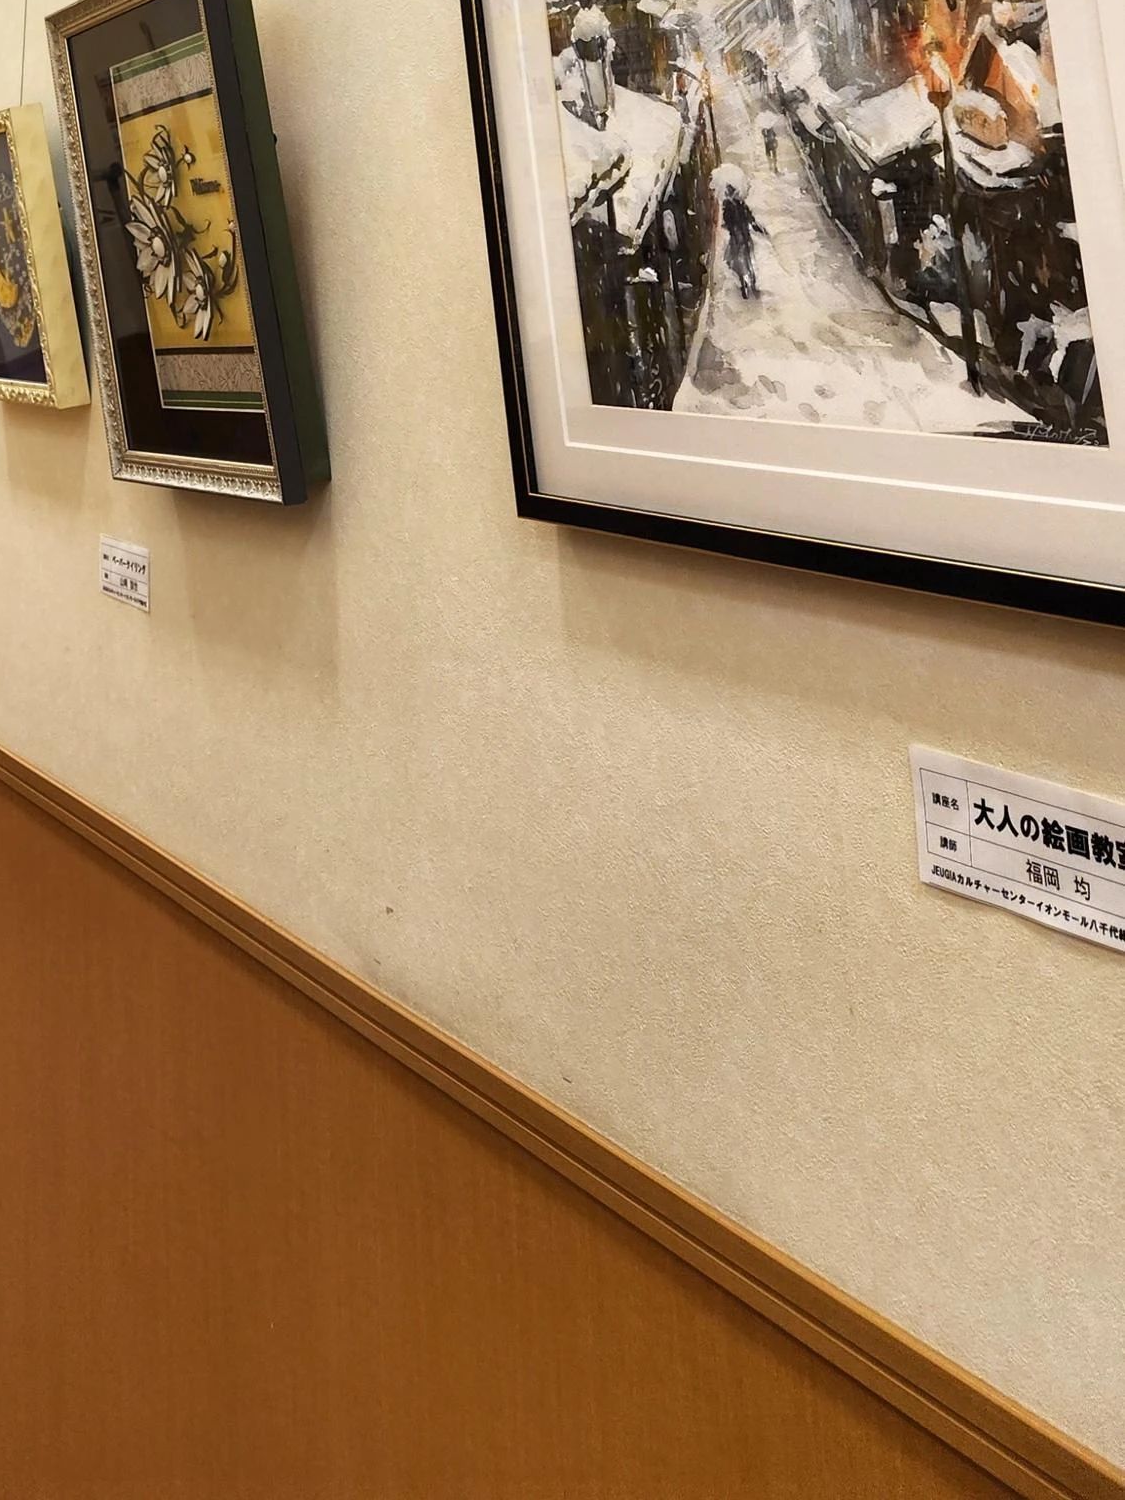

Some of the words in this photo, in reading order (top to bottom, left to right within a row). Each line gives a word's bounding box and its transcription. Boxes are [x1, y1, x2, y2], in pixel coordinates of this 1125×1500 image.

[932, 792, 959, 811] 講座名
[940, 836, 958, 852] 講師
[1026, 858, 1061, 890] 福岡
[1074, 875, 1091, 900] 均
